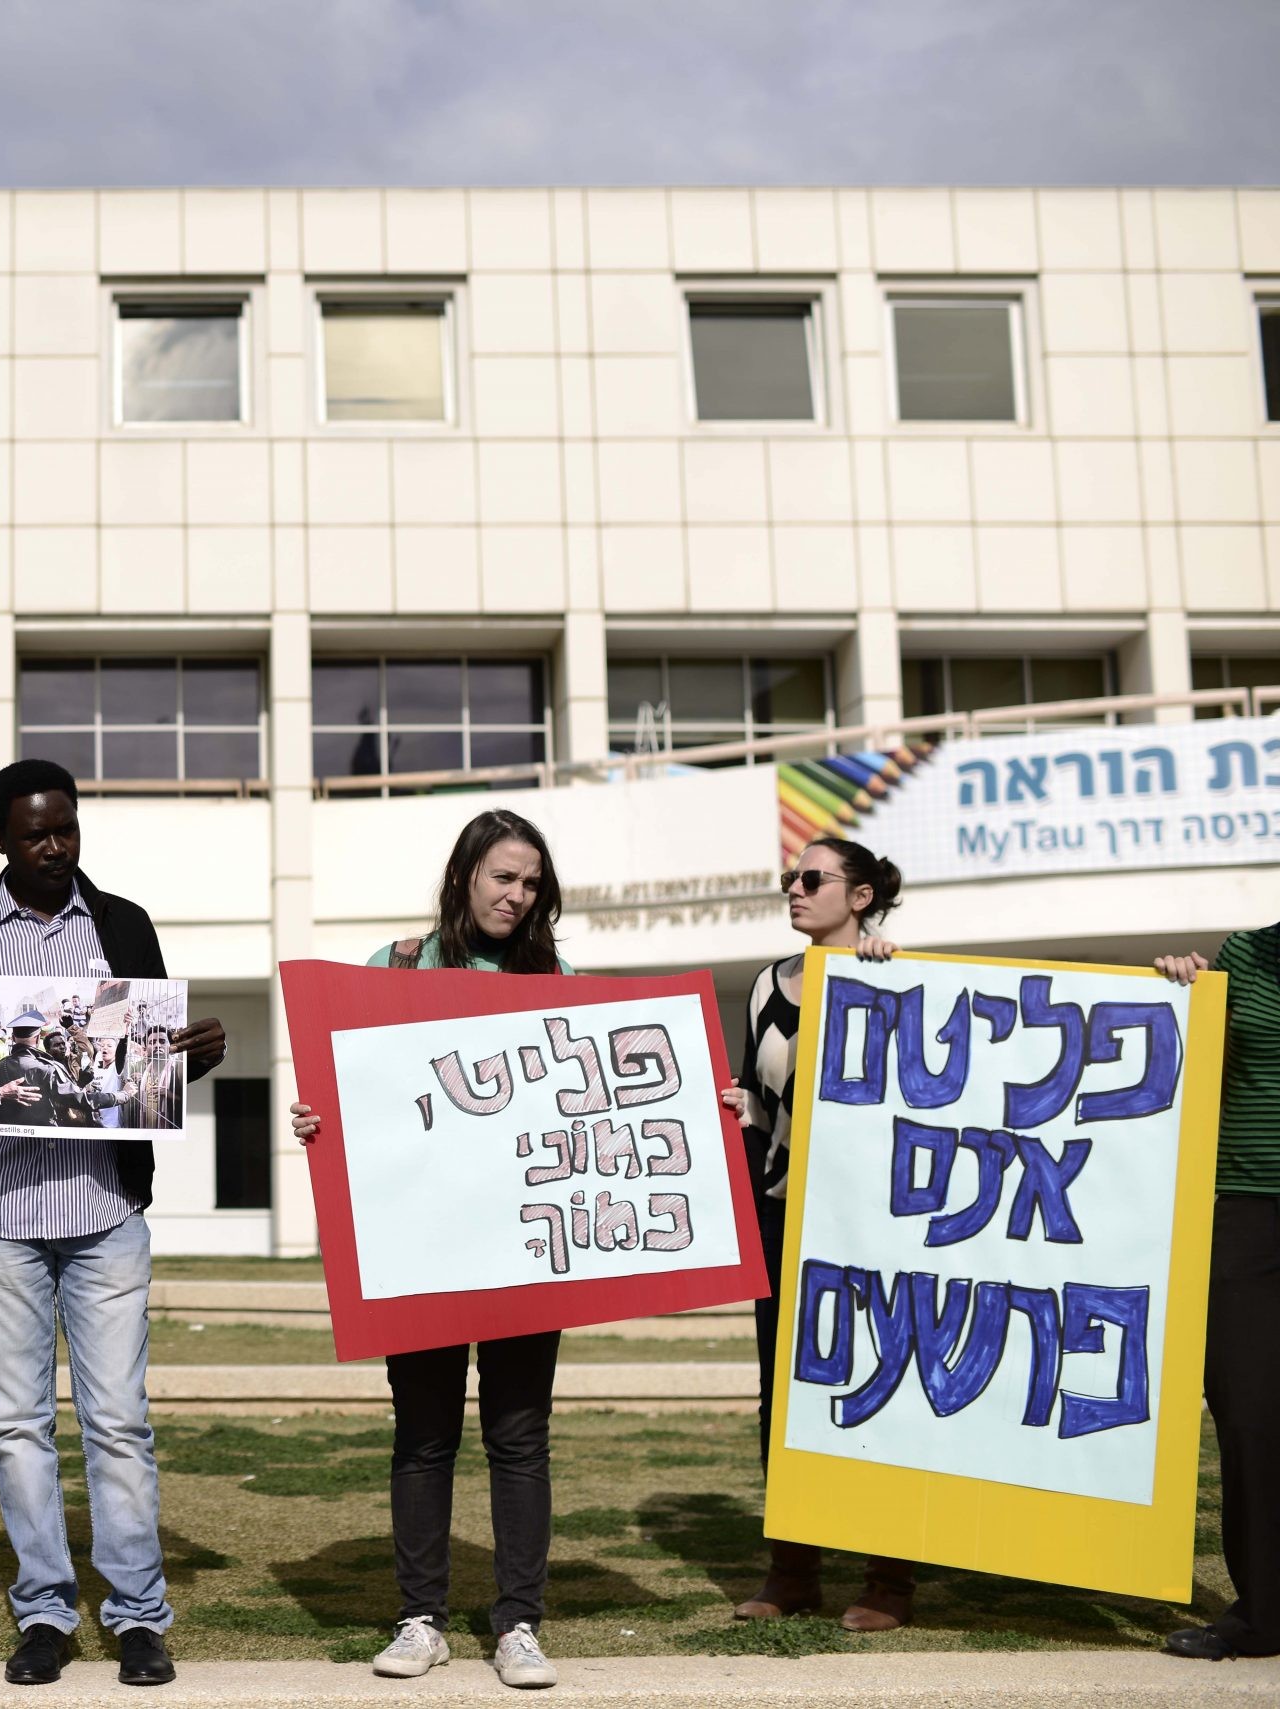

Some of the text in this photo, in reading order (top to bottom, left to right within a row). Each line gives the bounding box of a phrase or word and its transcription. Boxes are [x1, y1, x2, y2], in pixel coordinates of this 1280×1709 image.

[956, 745, 1177, 806] הוראה
[957, 818, 1085, 863] MyTau
[1097, 817, 1163, 855] דרך
[819, 974, 1184, 1129] פליטים
[890, 1114, 1093, 1247] אינם
